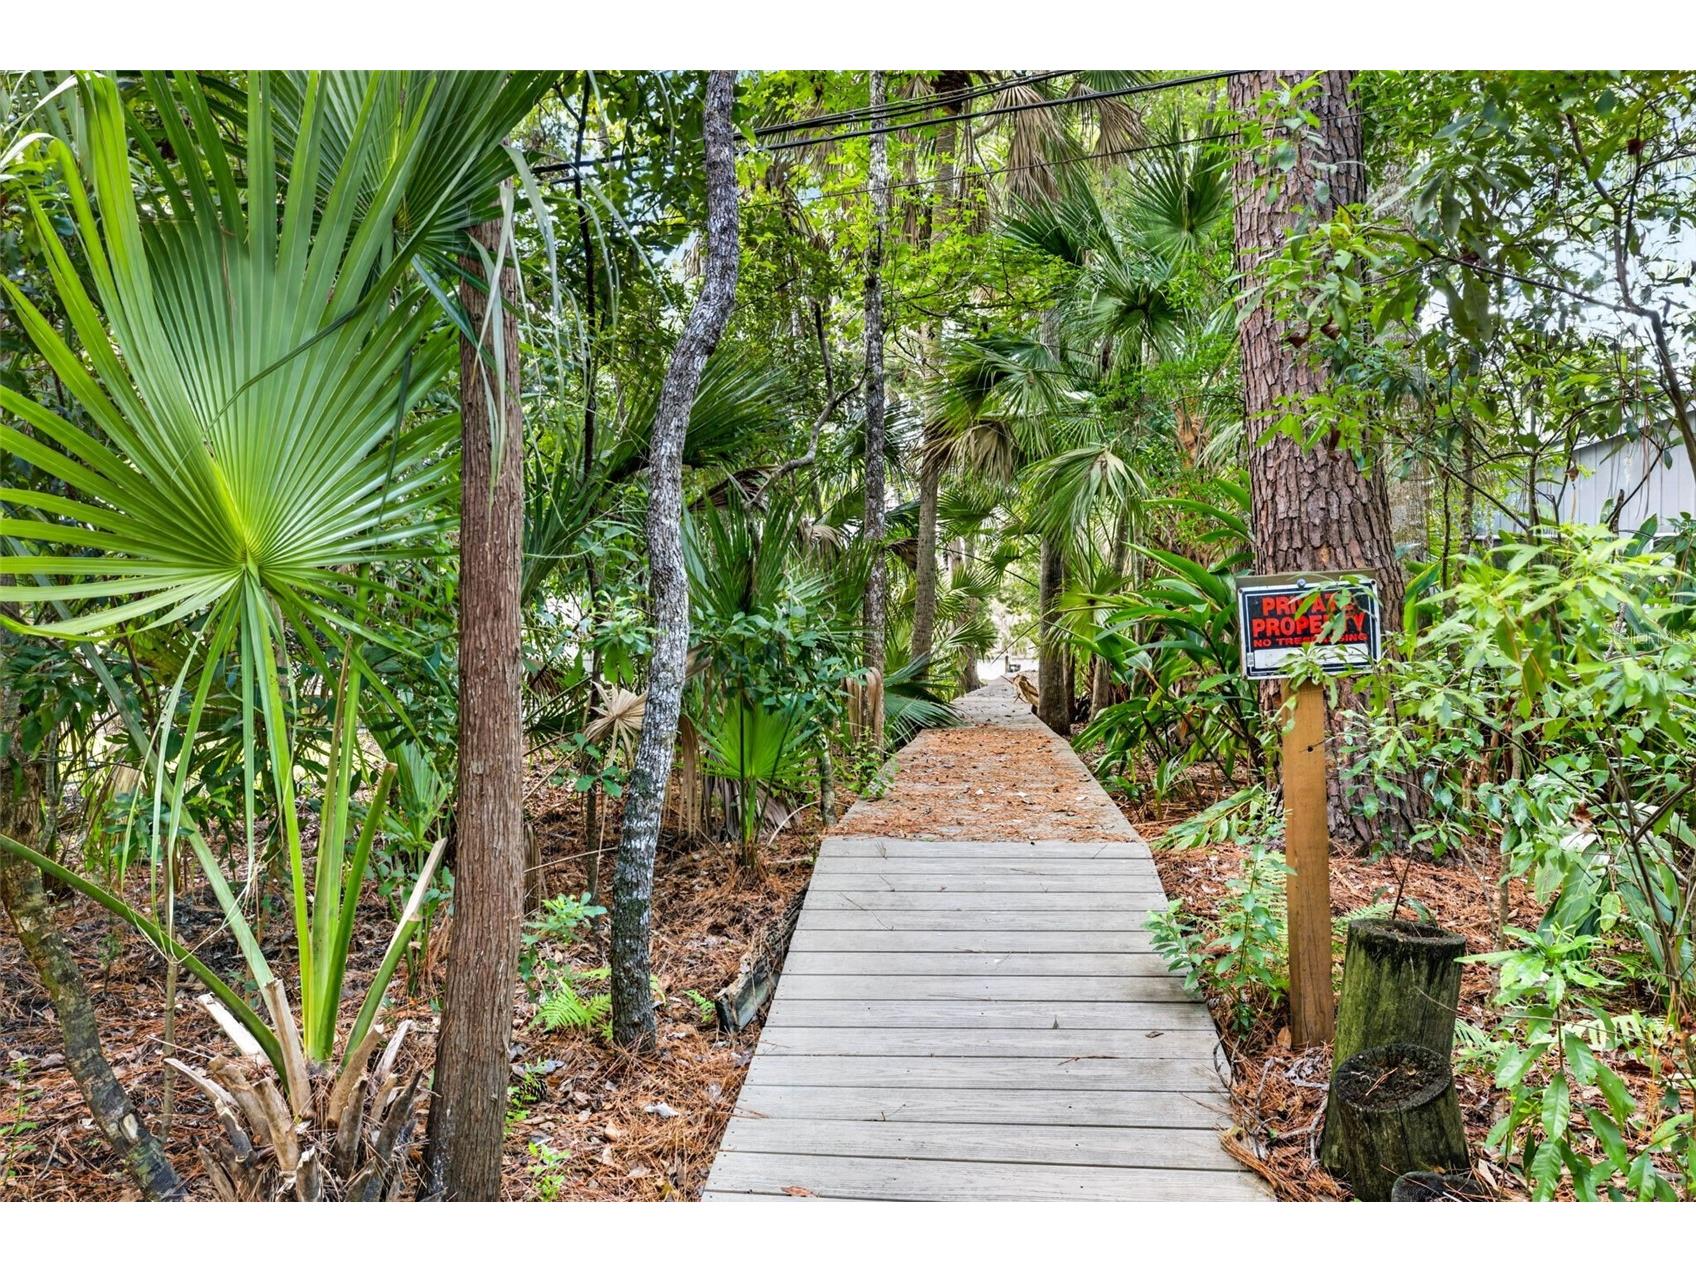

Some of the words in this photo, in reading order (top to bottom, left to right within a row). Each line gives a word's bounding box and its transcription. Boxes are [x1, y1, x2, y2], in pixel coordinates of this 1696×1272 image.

[1262, 592, 1356, 616] PRIAT
[1252, 612, 1365, 638] PROPEY
[1253, 638, 1272, 648] NO
[1276, 633, 1368, 646] TRESSING
